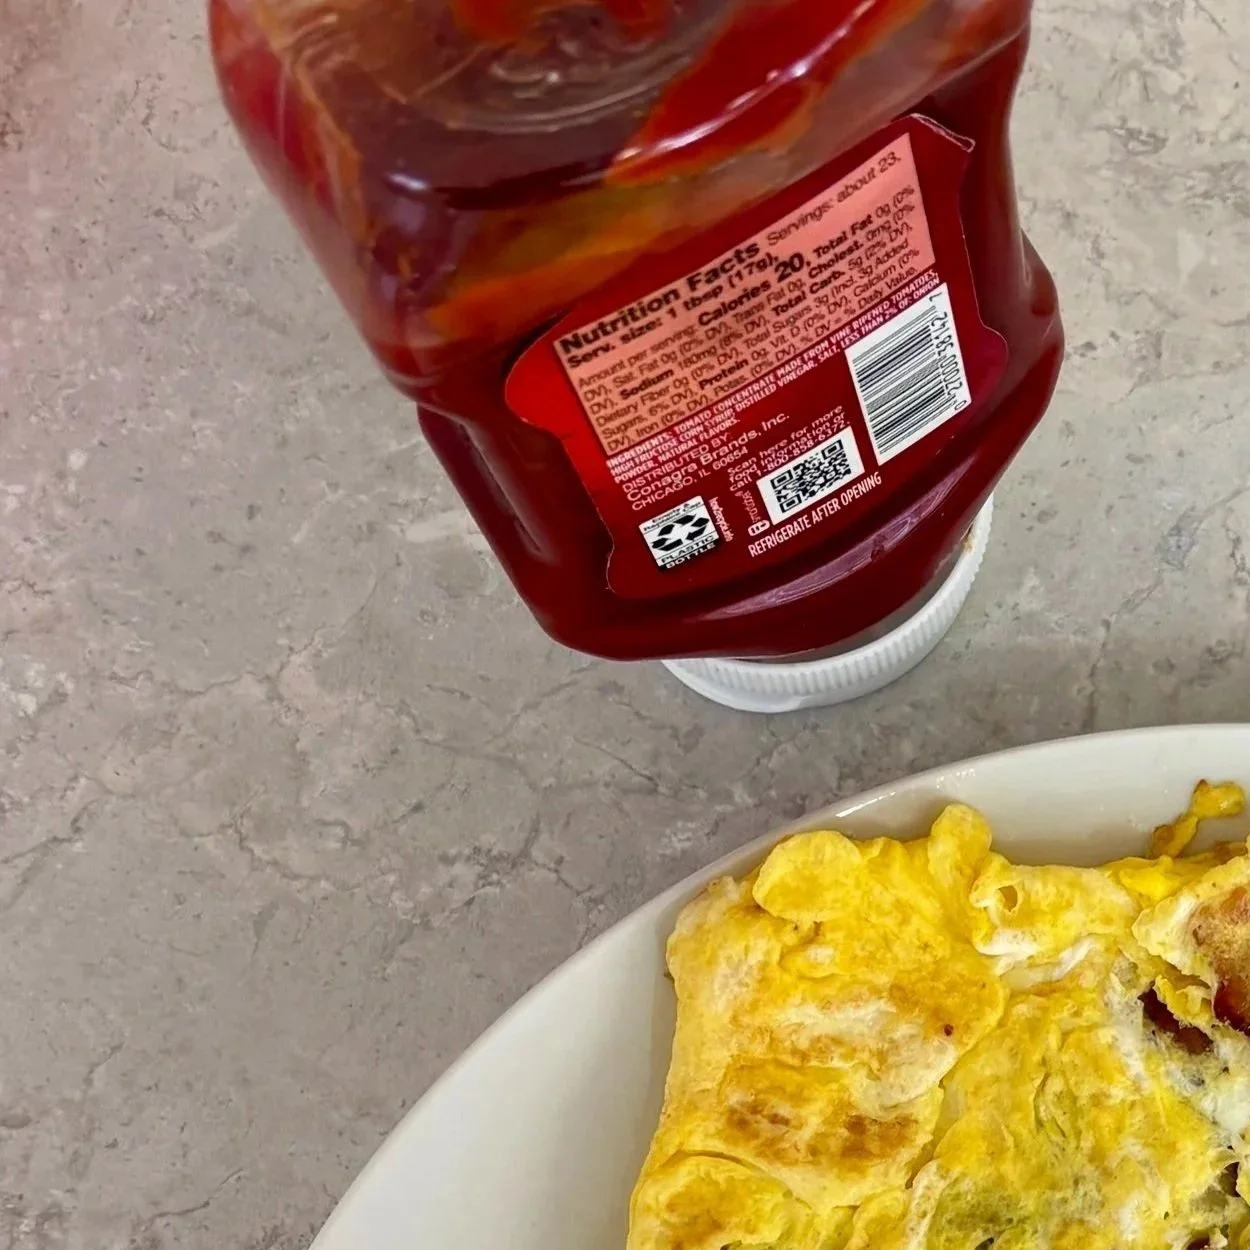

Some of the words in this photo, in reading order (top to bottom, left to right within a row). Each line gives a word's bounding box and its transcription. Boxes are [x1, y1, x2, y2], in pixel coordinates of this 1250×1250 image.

[560, 287, 681, 354] Nutrition
[686, 242, 760, 293] Facts
[765, 199, 833, 247] Servings:
[837, 167, 876, 203] about
[578, 359, 626, 389] Amount
[627, 349, 647, 367] per
[698, 280, 771, 327] Calories
[812, 230, 847, 259] Total
[850, 214, 873, 236] Fat
[875, 203, 891, 219] 0g
[892, 187, 914, 208] (0%
[638, 358, 659, 376] Fat
[660, 350, 678, 365] 0g
[731, 301, 765, 324] Trans
[766, 287, 785, 306] Fat
[808, 240, 863, 279] Cholest.
[865, 219, 891, 242] 0mg
[928, 292, 942, 302] 7
[567, 342, 616, 369] Serv.
[619, 317, 663, 345] size:
[666, 307, 677, 319] 1
[682, 284, 724, 312] tbsp
[595, 401, 639, 428] Dietary
[639, 385, 670, 406] Fiber
[672, 376, 690, 390] 0g
[743, 327, 771, 350] Total
[771, 305, 812, 334] Sugars
[874, 237, 908, 269] Added
[619, 368, 674, 401] Sodium
[771, 290, 807, 317] Total
[809, 270, 845, 295] Carb.
[847, 255, 863, 271] 5g
[635, 421, 659, 438] Iron
[814, 319, 831, 338] DV
[857, 287, 884, 310] Daily
[698, 358, 749, 391] Protein
[789, 325, 801, 338] D
[853, 264, 896, 298] Calcium
[930, 311, 953, 357] 38142
[610, 460, 635, 476] HIGH
[634, 438, 679, 465] FRUCTOSE
[679, 424, 704, 442] CORN
[734, 383, 776, 412] DISTILLED
[840, 330, 860, 348] LESS
[861, 315, 883, 335] THAN
[913, 274, 939, 299] ONION
[673, 410, 712, 434] TOMATO
[712, 373, 775, 414] CONCENTRATE
[776, 356, 803, 378] MADE
[803, 340, 829, 362] FROM
[830, 325, 851, 344] VINE
[852, 300, 890, 330] RIPENED
[939, 354, 962, 396] 27000
[954, 399, 966, 411] 0
[622, 444, 709, 493] DISTRIBUTED
[626, 462, 698, 507] Conagra
[699, 430, 762, 466] Brands,
[761, 413, 790, 431] Inc.
[631, 476, 697, 511] CHICAGO,
[698, 468, 710, 478] IL
[712, 446, 748, 471] 60654
[657, 438, 698, 463] NATURAL
[727, 457, 757, 478] Scan
[759, 439, 788, 459] here
[790, 426, 808, 441] for
[811, 405, 843, 428] more
[729, 463, 758, 483] food
[760, 417, 831, 467] information
[833, 412, 845, 423] or
[729, 474, 752, 491] call
[748, 514, 811, 557] REFRIGERATE
[811, 498, 841, 525] AFTER
[840, 471, 882, 506] OPENING
[661, 532, 714, 565] PLASTIC
[666, 539, 715, 569] BOTTLE
